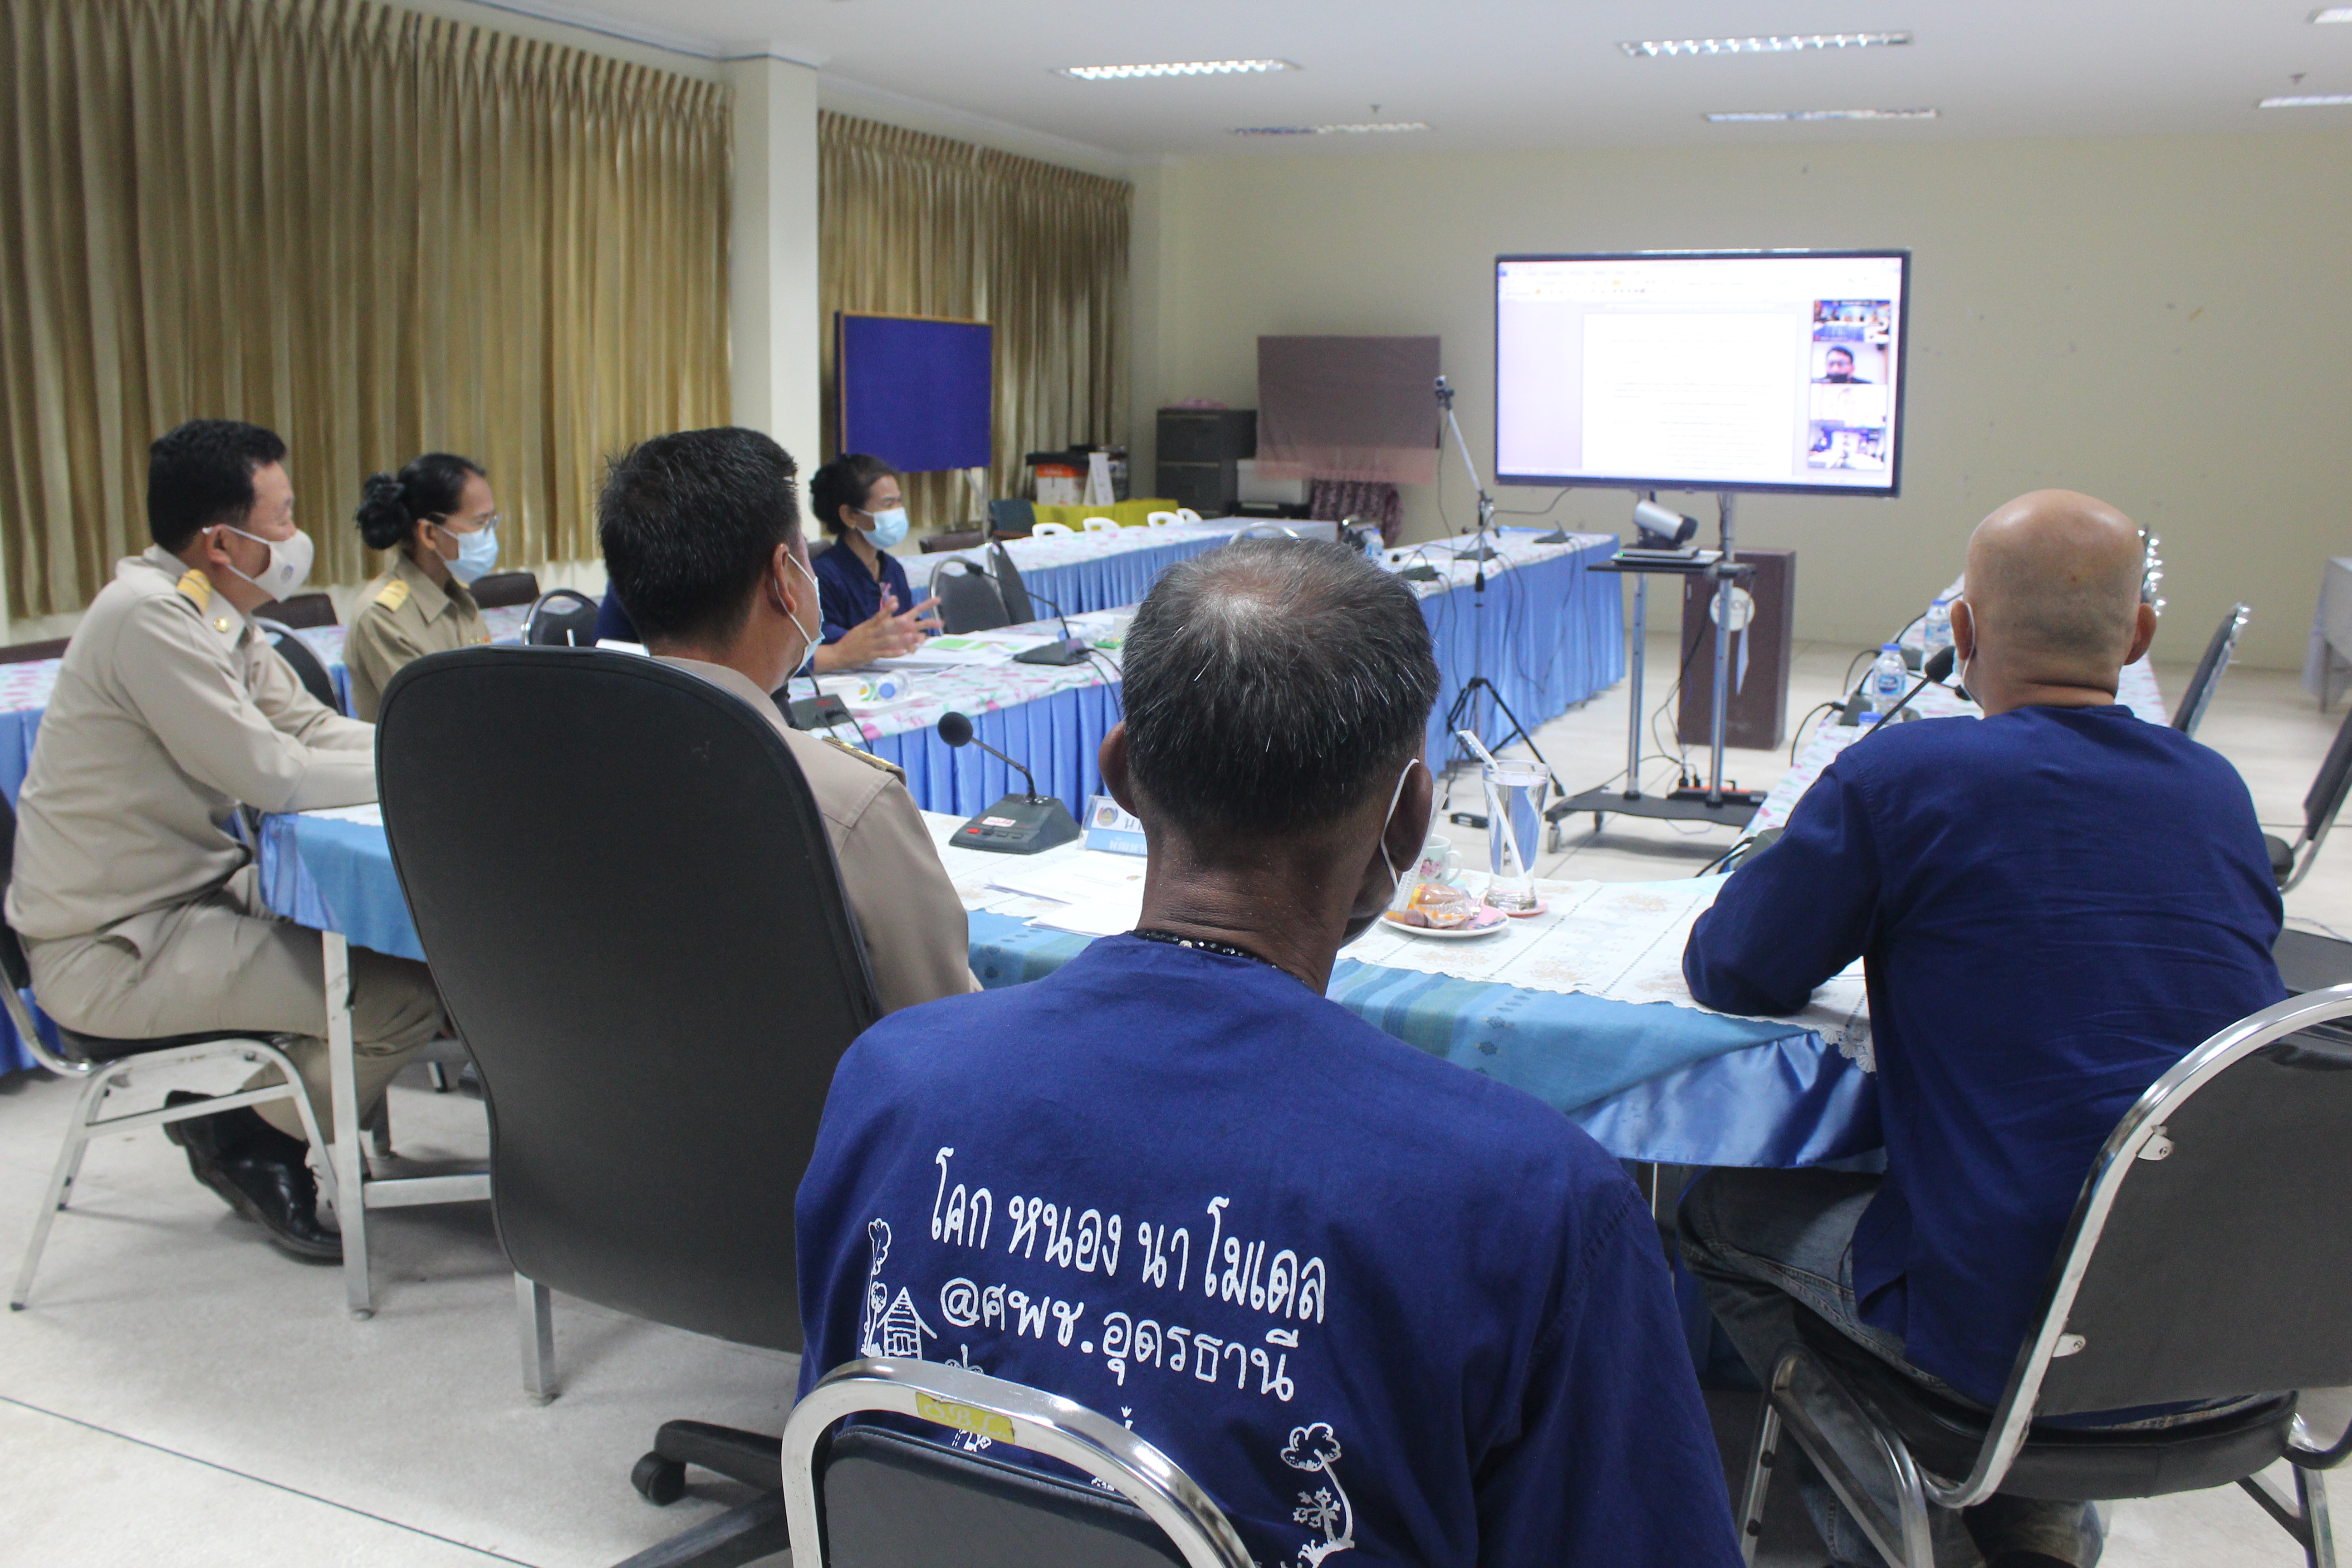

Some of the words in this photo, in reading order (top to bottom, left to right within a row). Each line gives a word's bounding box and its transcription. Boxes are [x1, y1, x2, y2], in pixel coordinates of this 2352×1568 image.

[931, 1146, 992, 1250] โคก
[1008, 1195, 1122, 1277] หนอง
[1138, 1221, 1190, 1291] นา
[1205, 1196, 1326, 1324] โมเดล
[940, 1277, 1299, 1402] @ศพช.อุดรธานี
